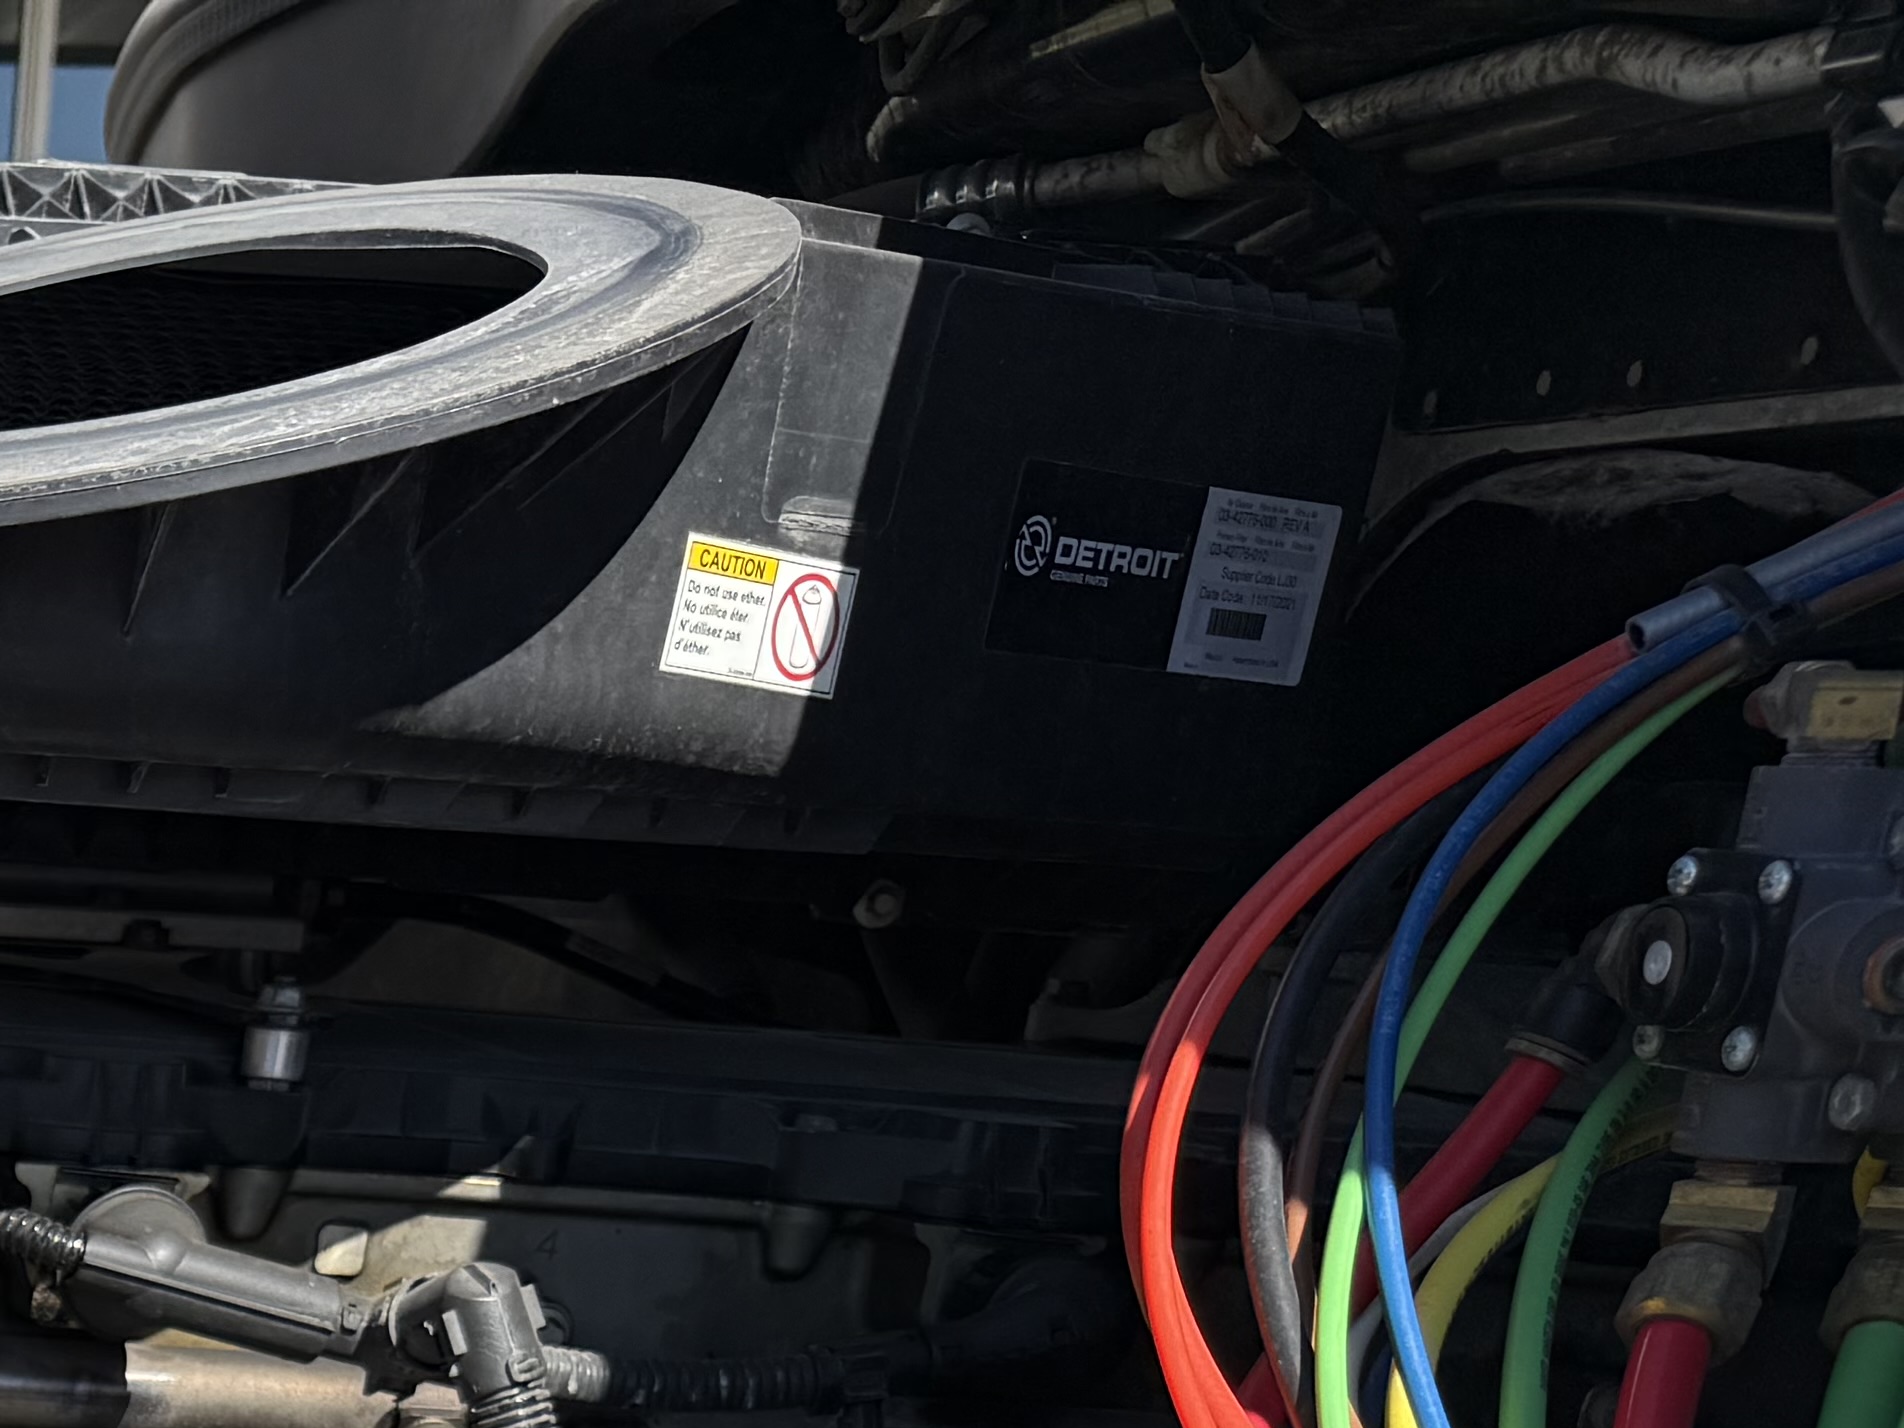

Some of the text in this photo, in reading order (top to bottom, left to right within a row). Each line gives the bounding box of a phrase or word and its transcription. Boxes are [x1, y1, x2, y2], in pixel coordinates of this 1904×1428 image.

[699, 549, 767, 579] CAUTION
[1054, 536, 1181, 579] DETROIT
[1221, 566, 1254, 584] Supplier
[687, 580, 701, 593] Do
[704, 584, 720, 598] not
[722, 589, 738, 602] use
[683, 599, 697, 613] No
[724, 629, 741, 643] pas
